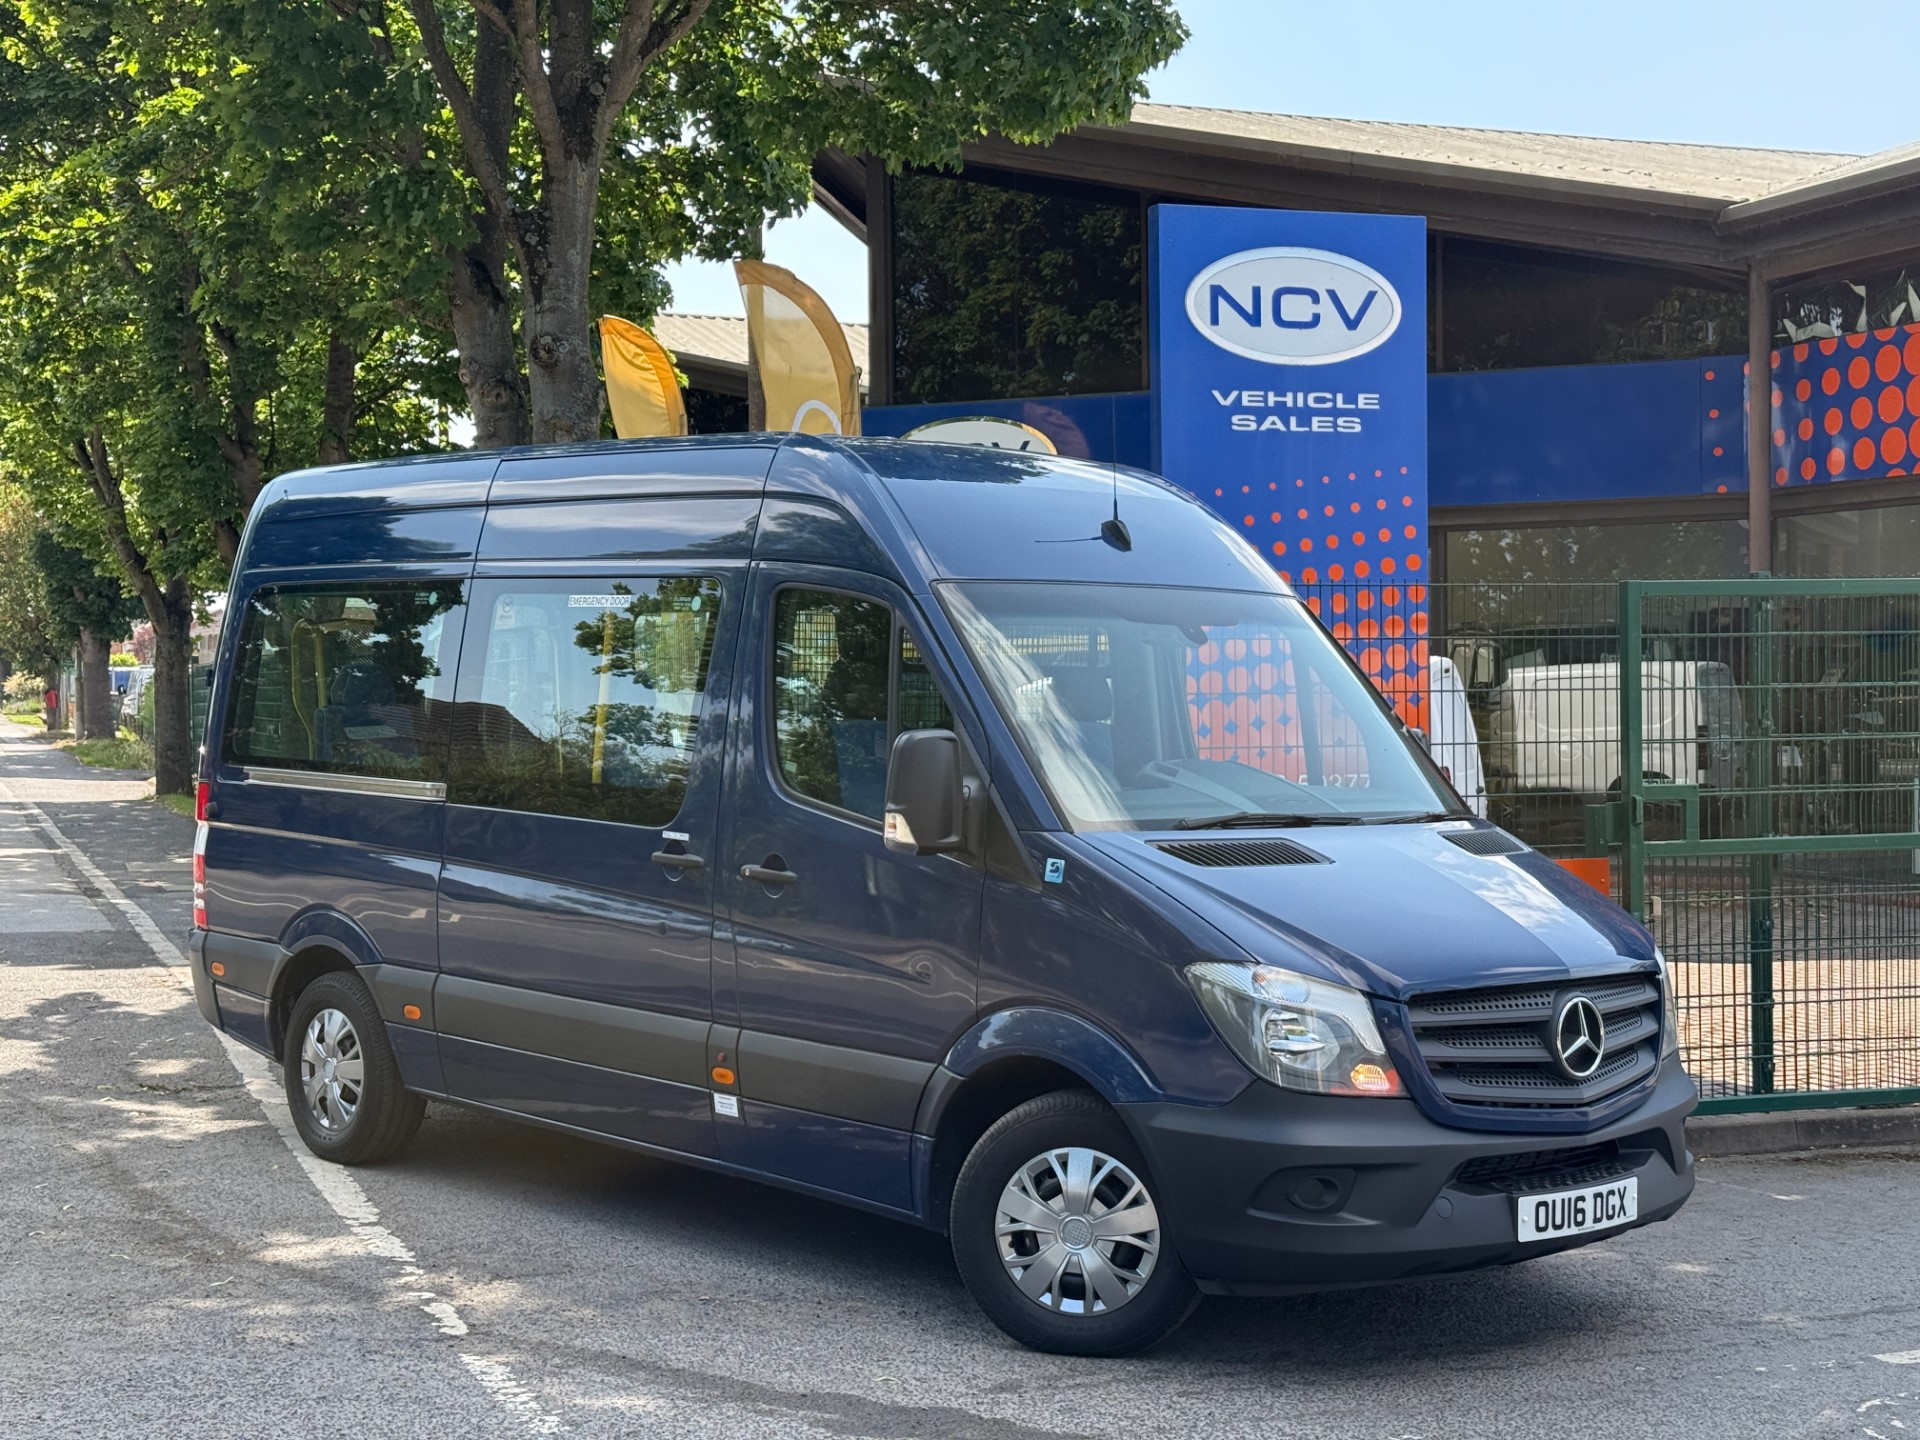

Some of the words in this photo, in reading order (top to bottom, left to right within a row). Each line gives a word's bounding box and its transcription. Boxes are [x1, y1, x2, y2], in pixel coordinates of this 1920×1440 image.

[1209, 284, 1378, 331] NCV
[1211, 390, 1380, 409] VEHICLE
[1231, 415, 1362, 433] SALES
[569, 596, 609, 606] EMERGENCY
[610, 596, 630, 606] DOOR
[1535, 1195, 1586, 1233] OU16
[1592, 1186, 1627, 1224] DGX
